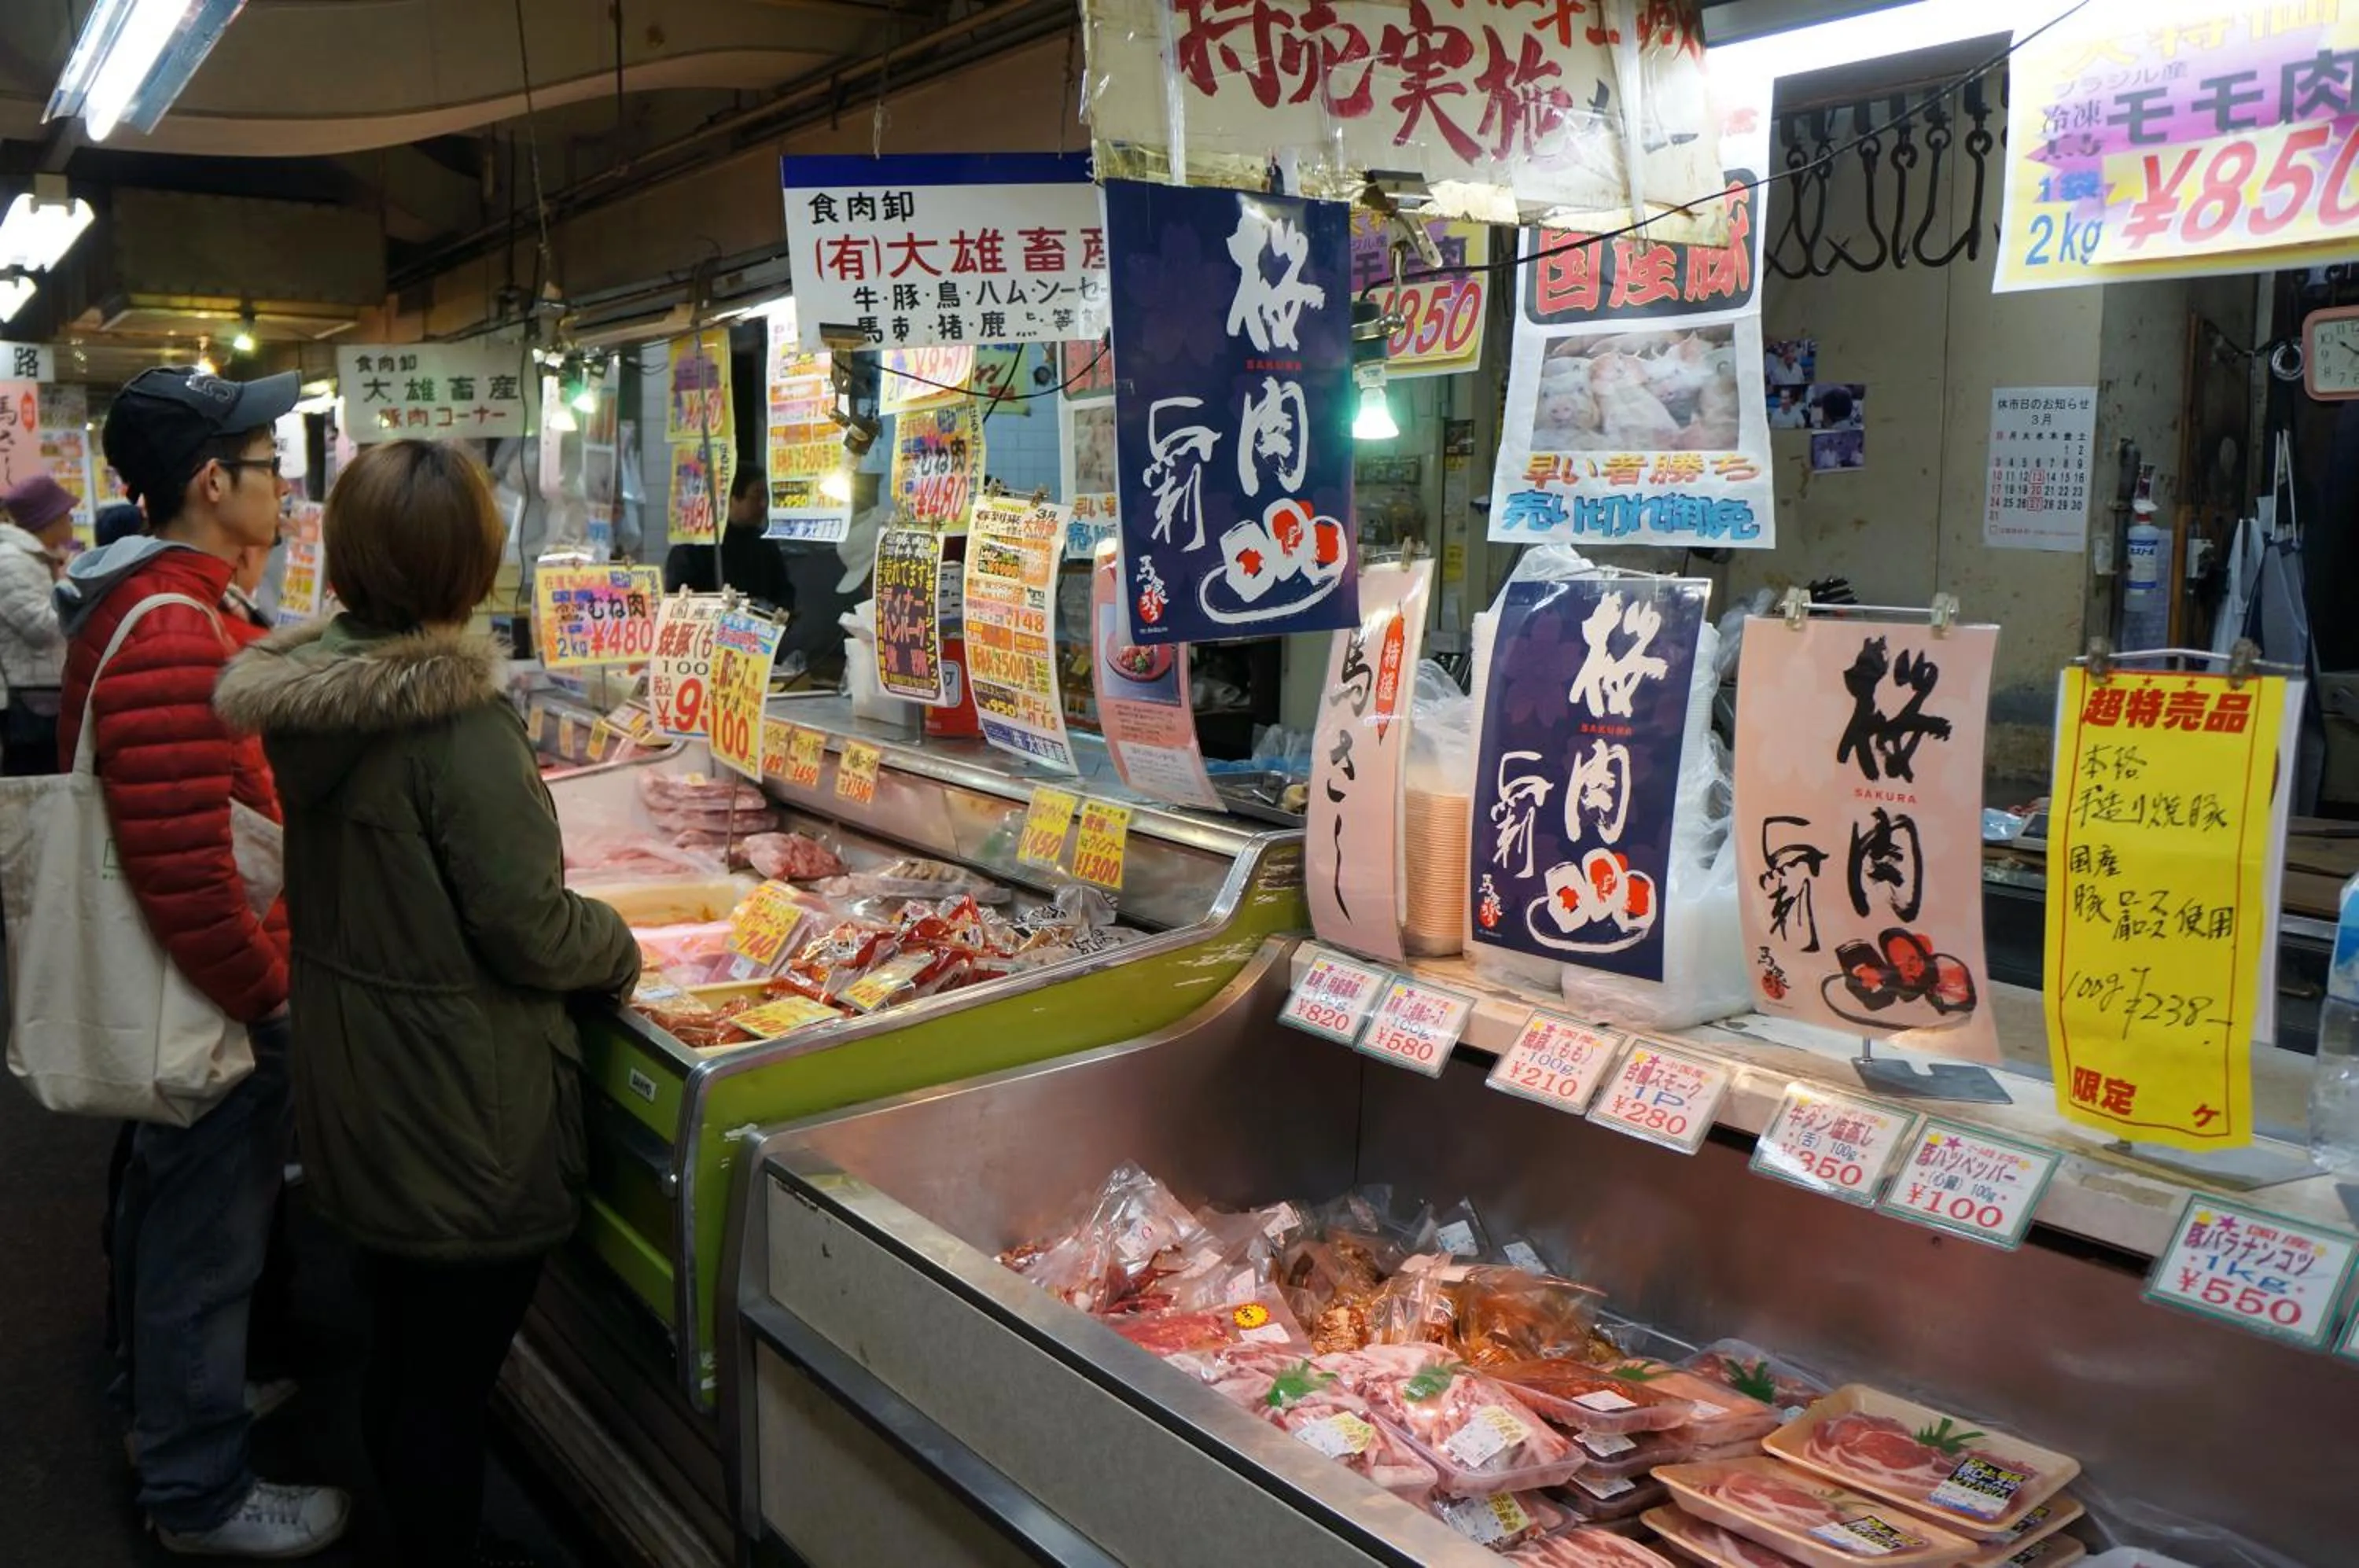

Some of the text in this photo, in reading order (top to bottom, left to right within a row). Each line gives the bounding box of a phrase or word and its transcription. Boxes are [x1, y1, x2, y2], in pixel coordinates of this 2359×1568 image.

[808, 191, 915, 225] 食肉卸
[355, 354, 418, 374] 食肉卸
[362, 374, 519, 403] 大雄畜産
[2031, 414, 2052, 426] 3月
[1522, 453, 1761, 490] 早い者勝ち
[2046, 472, 2056, 483] 14
[2074, 472, 2085, 483] 16
[2058, 485, 2069, 497] 22
[2072, 485, 2083, 497] 23
[2070, 499, 2082, 511] 30
[588, 591, 646, 620] むね肉
[558, 637, 587, 658] 2kg
[591, 619, 655, 659] ¥480
[2081, 686, 2254, 734] 超特売品
[1580, 723, 1634, 738] SAKURA
[2082, 745, 2148, 779] 本格
[1853, 787, 1918, 804] SAKURA
[2069, 844, 2123, 878] 国産
[2174, 897, 2235, 939] 使用
[1296, 998, 1350, 1031] ¥820
[1376, 1026, 1434, 1061] ¥580
[1509, 1061, 1578, 1097] ¥210
[1529, 1051, 1576, 1077] 100g
[2072, 1066, 2138, 1116] 限定
[1611, 1094, 1687, 1135] ¥280
[1830, 1142, 1858, 1161] 100g
[1905, 1182, 2004, 1228] ¥100
[2177, 1265, 2303, 1327] ¥550
